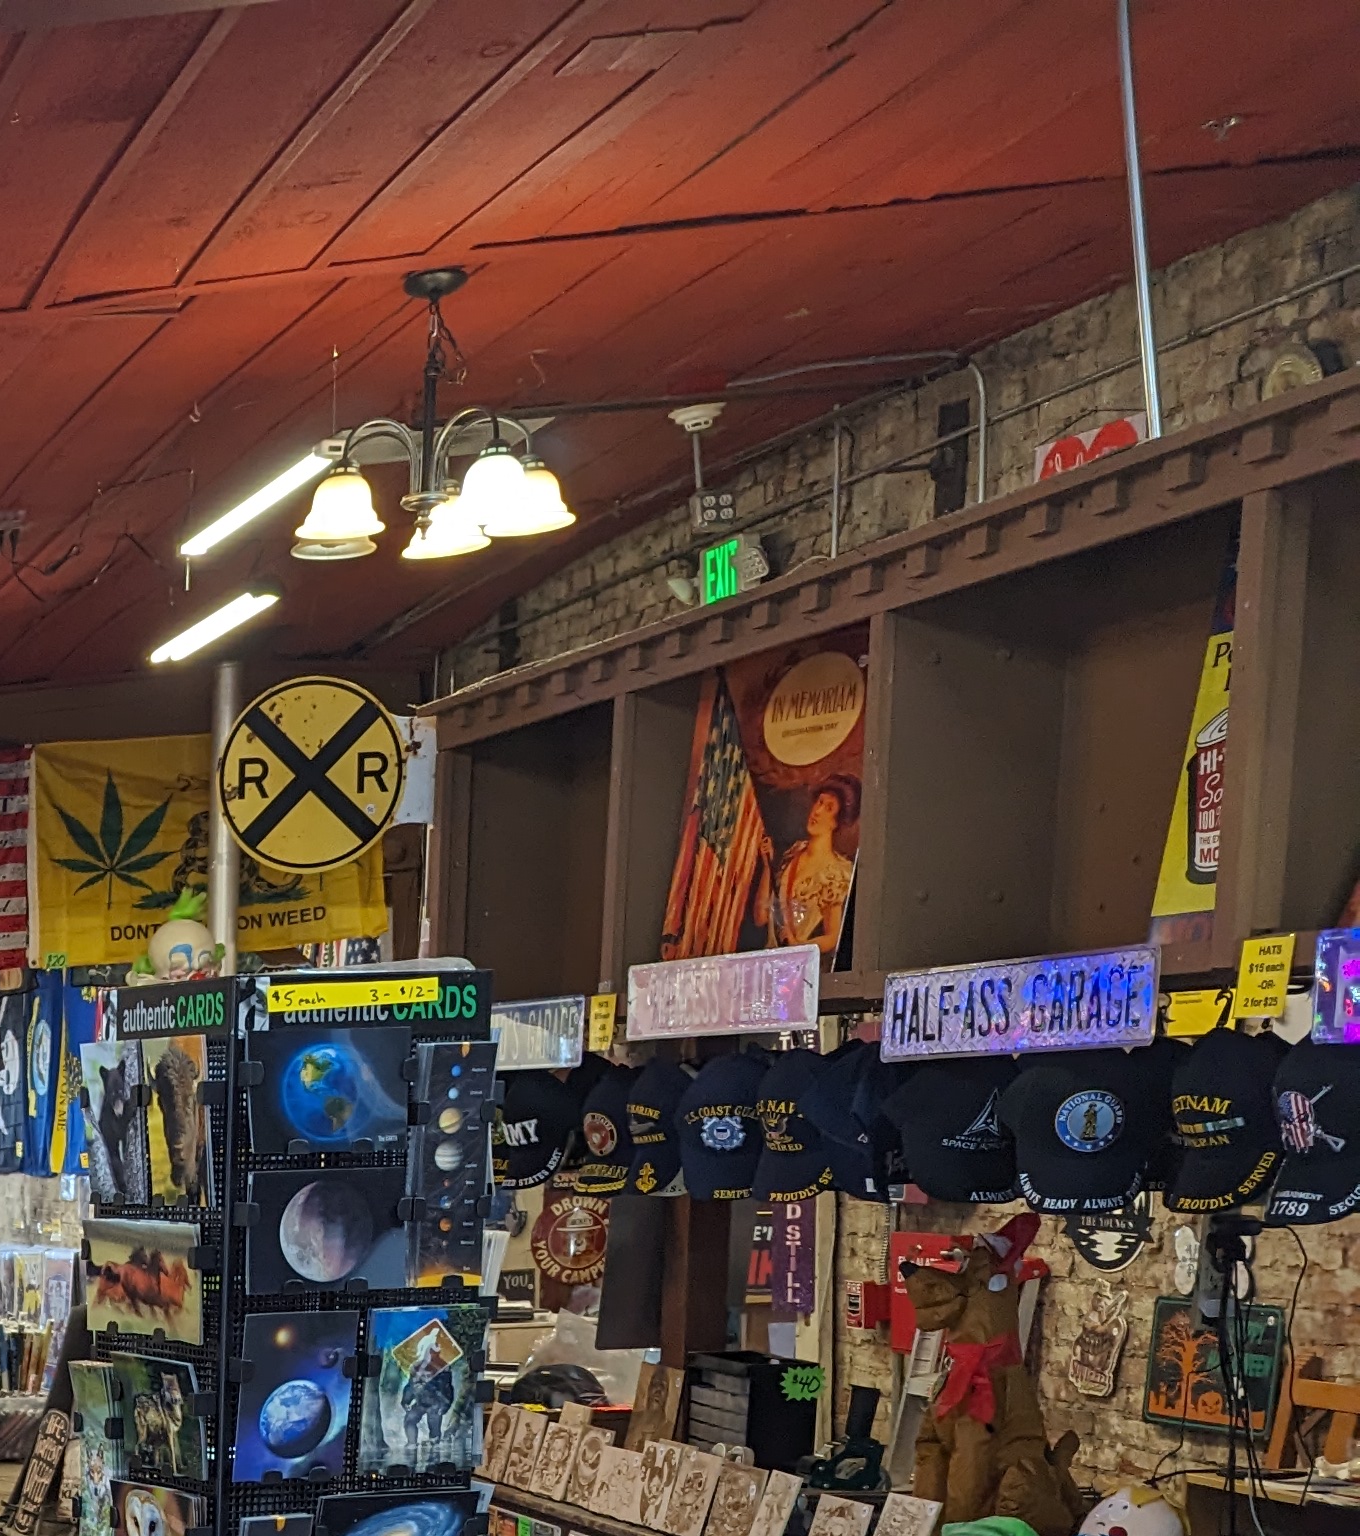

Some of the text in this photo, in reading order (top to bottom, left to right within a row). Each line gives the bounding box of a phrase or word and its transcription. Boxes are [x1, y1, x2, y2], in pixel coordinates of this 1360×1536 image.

[705, 539, 738, 605] EXIT
[786, 682, 857, 721] MEMORIAM
[238, 751, 388, 799] R R
[110, 924, 162, 942] DONT
[237, 905, 327, 932] ON WEED
[1266, 962, 1285, 972] each
[122, 990, 224, 1033] authentic CARDS
[890, 962, 1140, 1047] HALF-ASS GARAGE
[699, 1105, 732, 1119] COAST
[1059, 1091, 1103, 1123] NATIONAL
[941, 1138, 977, 1150] SPACE
[769, 1184, 820, 1202] PROUDLY
[1019, 1172, 1124, 1209] ALWAYS READY ALWAYS
[1177, 1151, 1276, 1211] PROUDLY SERVED
[550, 1196, 608, 1217] DROWN
[1270, 1201, 1309, 1217] 1789
